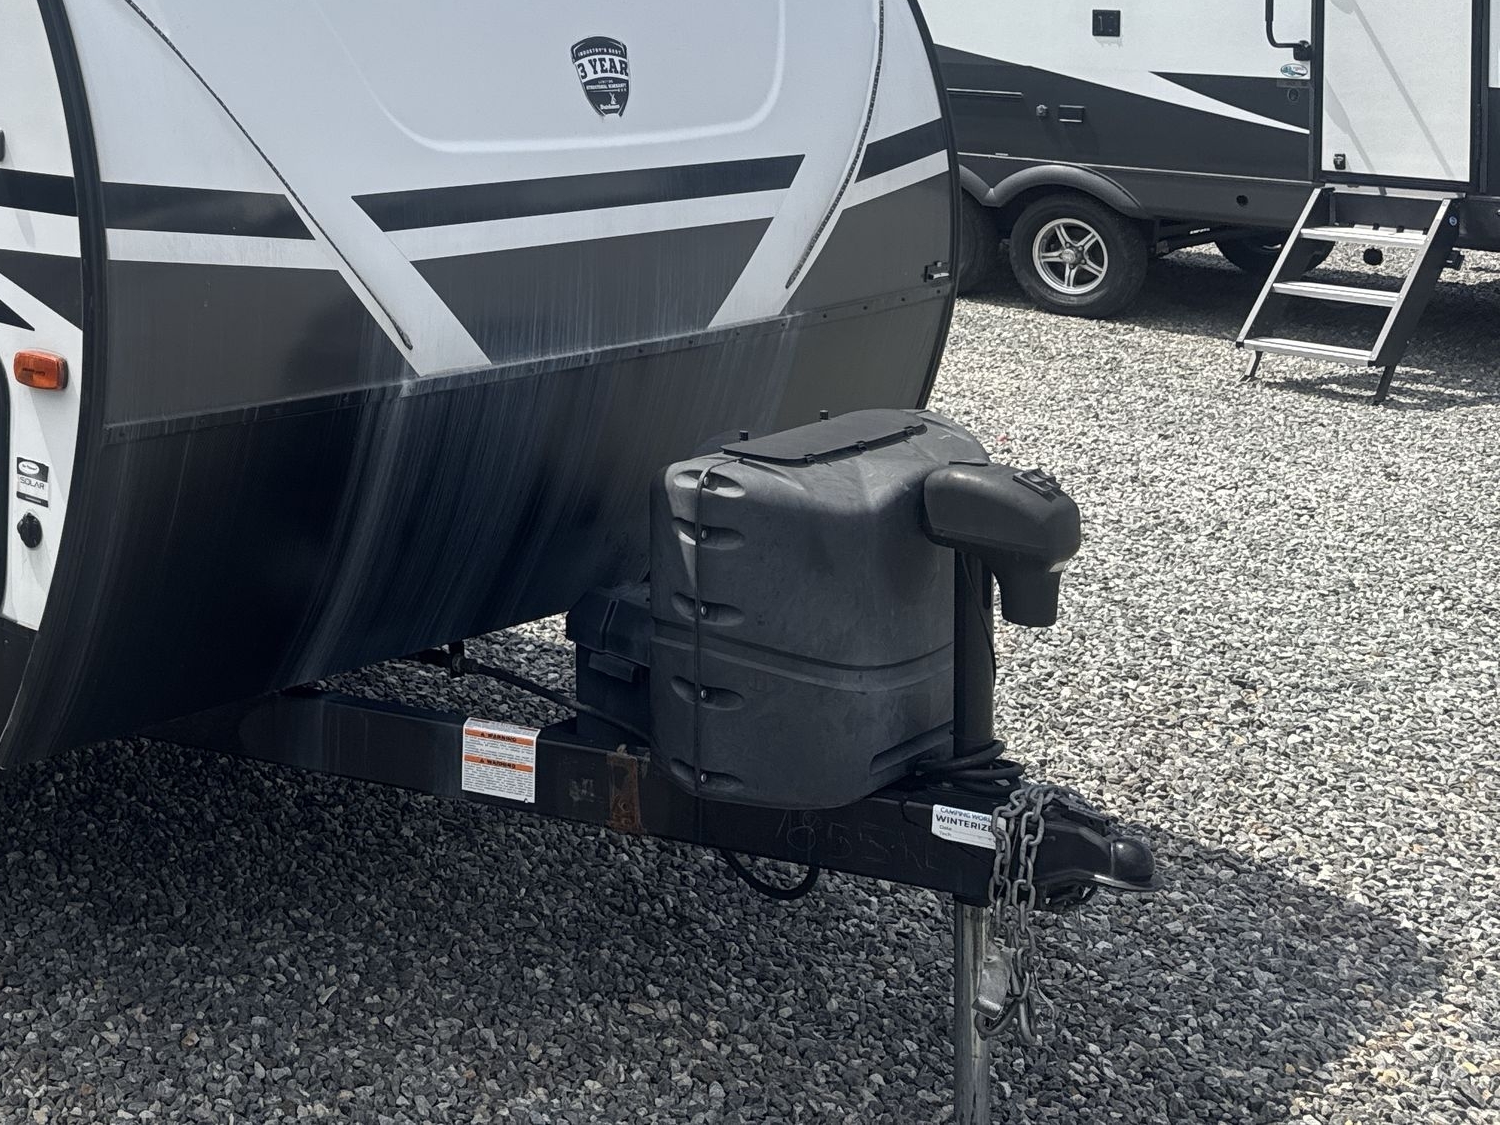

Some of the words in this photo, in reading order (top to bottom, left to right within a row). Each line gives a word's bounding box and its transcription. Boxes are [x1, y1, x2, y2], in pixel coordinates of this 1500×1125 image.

[577, 62, 588, 80] 3
[587, 57, 629, 77] YEAR
[19, 476, 45, 490] SOLAR
[935, 813, 994, 833] WINTERIZE
[940, 806, 972, 819] CAMPING
[971, 813, 992, 823] WORL
